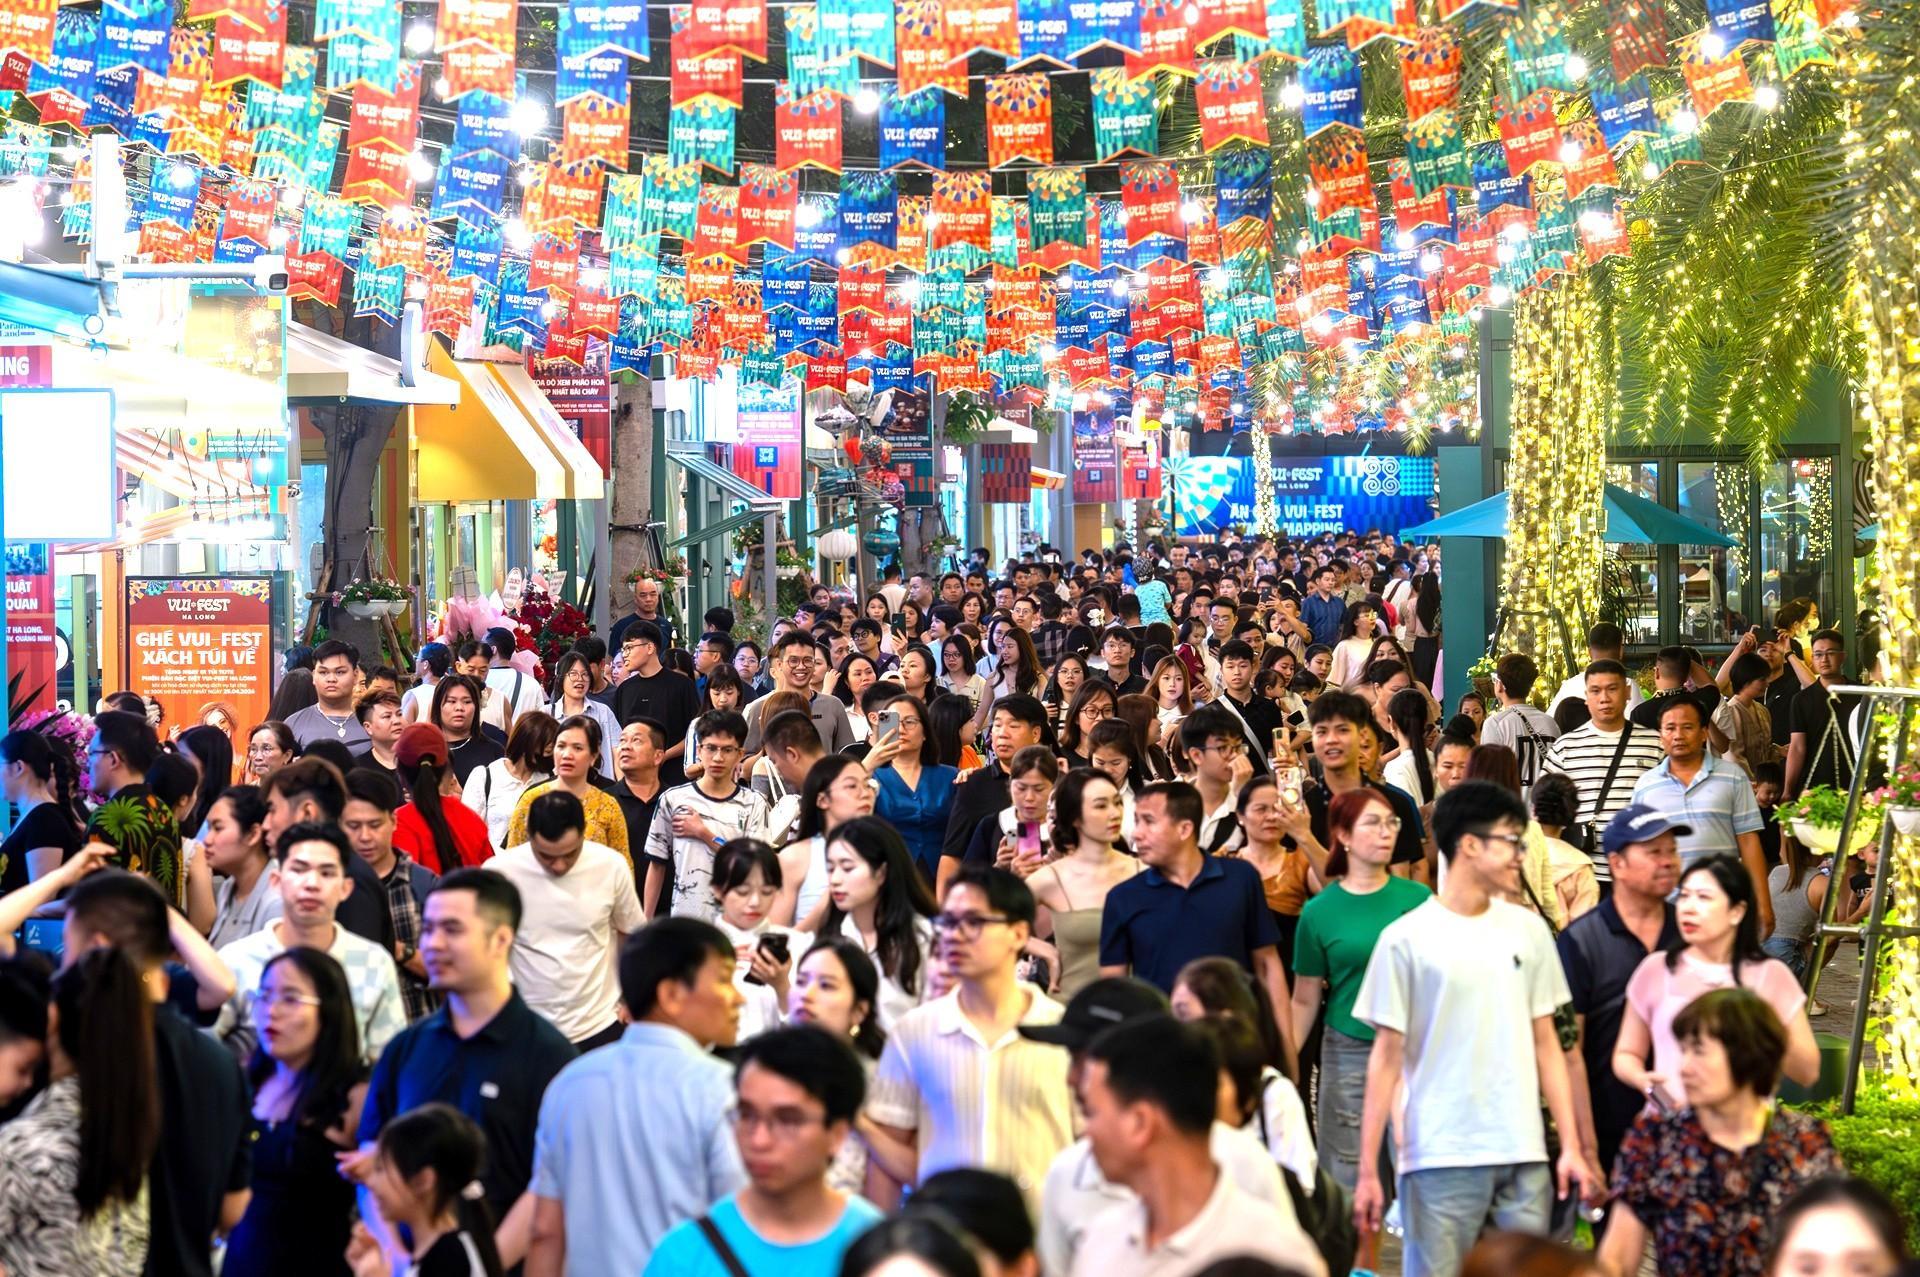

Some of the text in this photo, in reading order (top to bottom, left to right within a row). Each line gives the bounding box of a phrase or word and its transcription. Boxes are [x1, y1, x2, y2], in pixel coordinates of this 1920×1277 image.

[135, 629, 174, 647] GHÉ
[142, 645, 257, 665] XÁCH TÚI VỀ
